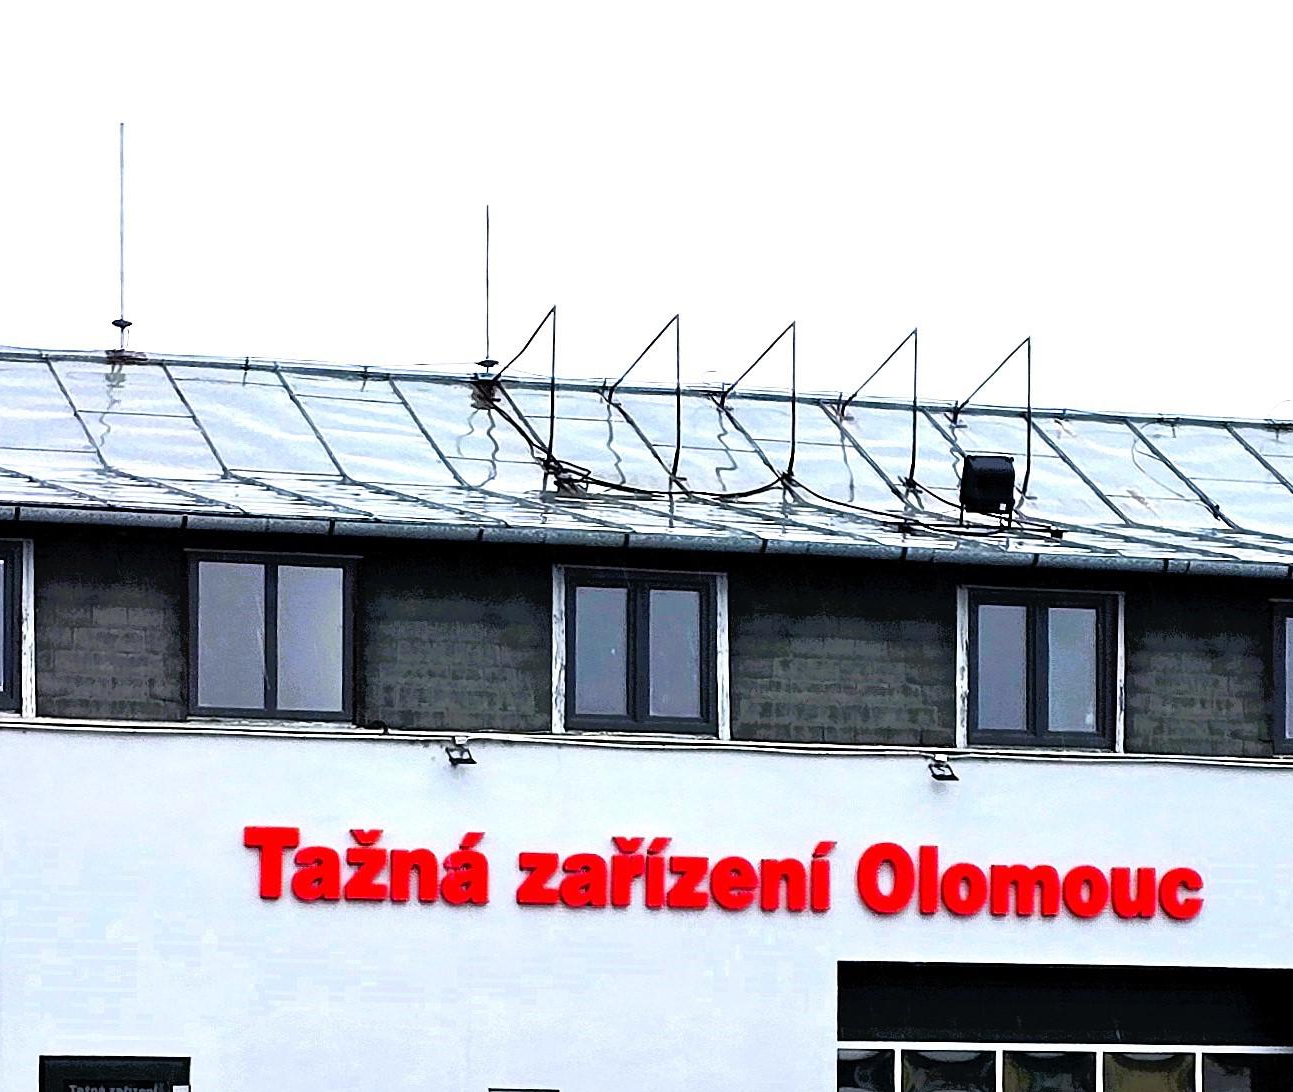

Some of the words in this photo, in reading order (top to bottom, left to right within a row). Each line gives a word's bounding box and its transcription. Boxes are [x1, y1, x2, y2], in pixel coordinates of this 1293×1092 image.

[243, 826, 490, 905] Tažná
[515, 836, 836, 912] zařízení
[856, 842, 1204, 919] Olomouc
